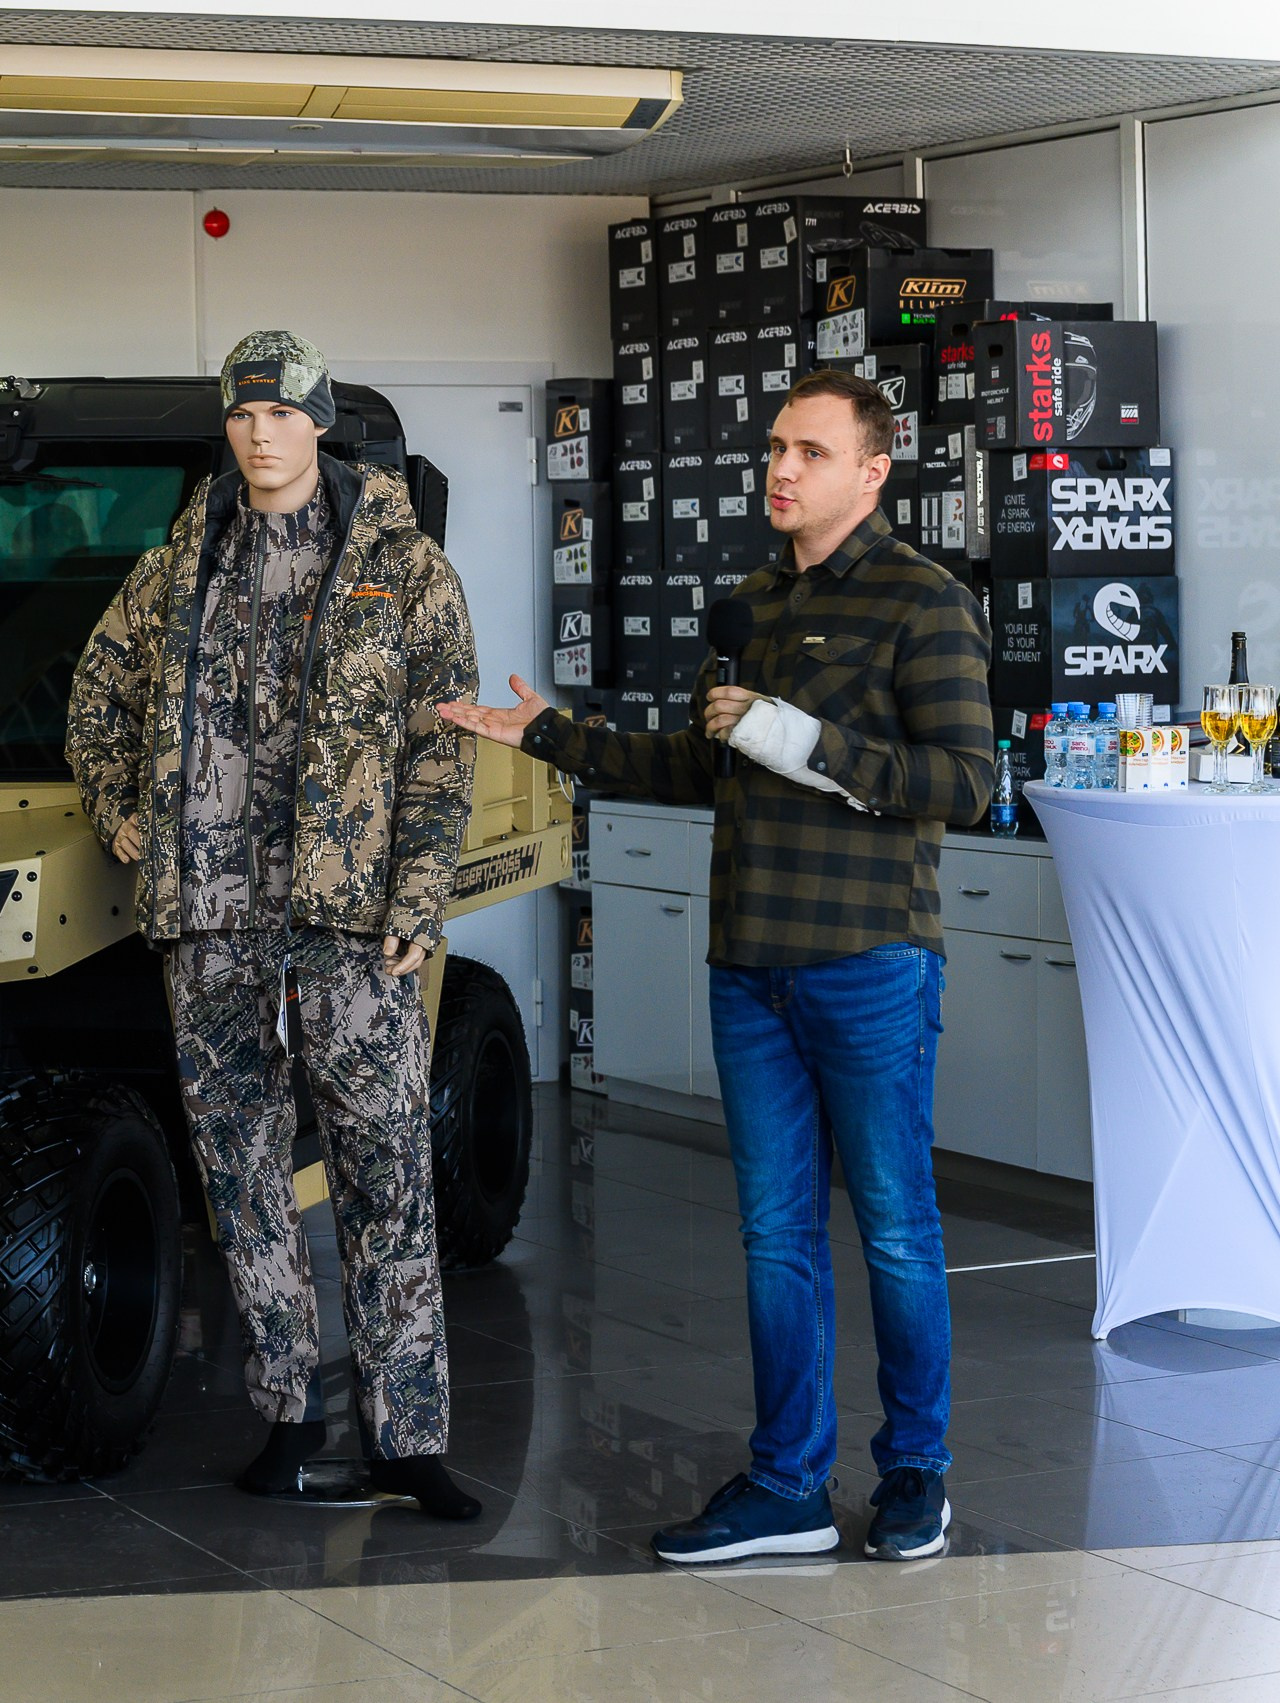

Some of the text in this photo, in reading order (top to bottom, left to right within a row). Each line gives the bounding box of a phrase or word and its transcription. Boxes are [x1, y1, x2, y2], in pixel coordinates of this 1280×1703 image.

[863, 203, 921, 214] ACERBIS
[829, 279, 853, 308] K
[941, 342, 975, 363] starks
[1025, 331, 1053, 442] starks
[1051, 357, 1063, 417] safe ride
[557, 409, 578, 433] K
[1004, 494, 1026, 505] IGNITE
[1051, 477, 1172, 512] SPARX
[563, 512, 581, 537] K
[1001, 508, 1030, 519] A SPARK
[997, 522, 1036, 533] OF ENERGY
[1052, 516, 1172, 551] SPARX
[562, 614, 581, 639] K
[1004, 623, 1039, 635] YOUR LIFE
[1007, 637, 1036, 648] IS YOUR
[1002, 650, 1041, 662] MOVEMENT
[1064, 644, 1169, 676] SPARX
